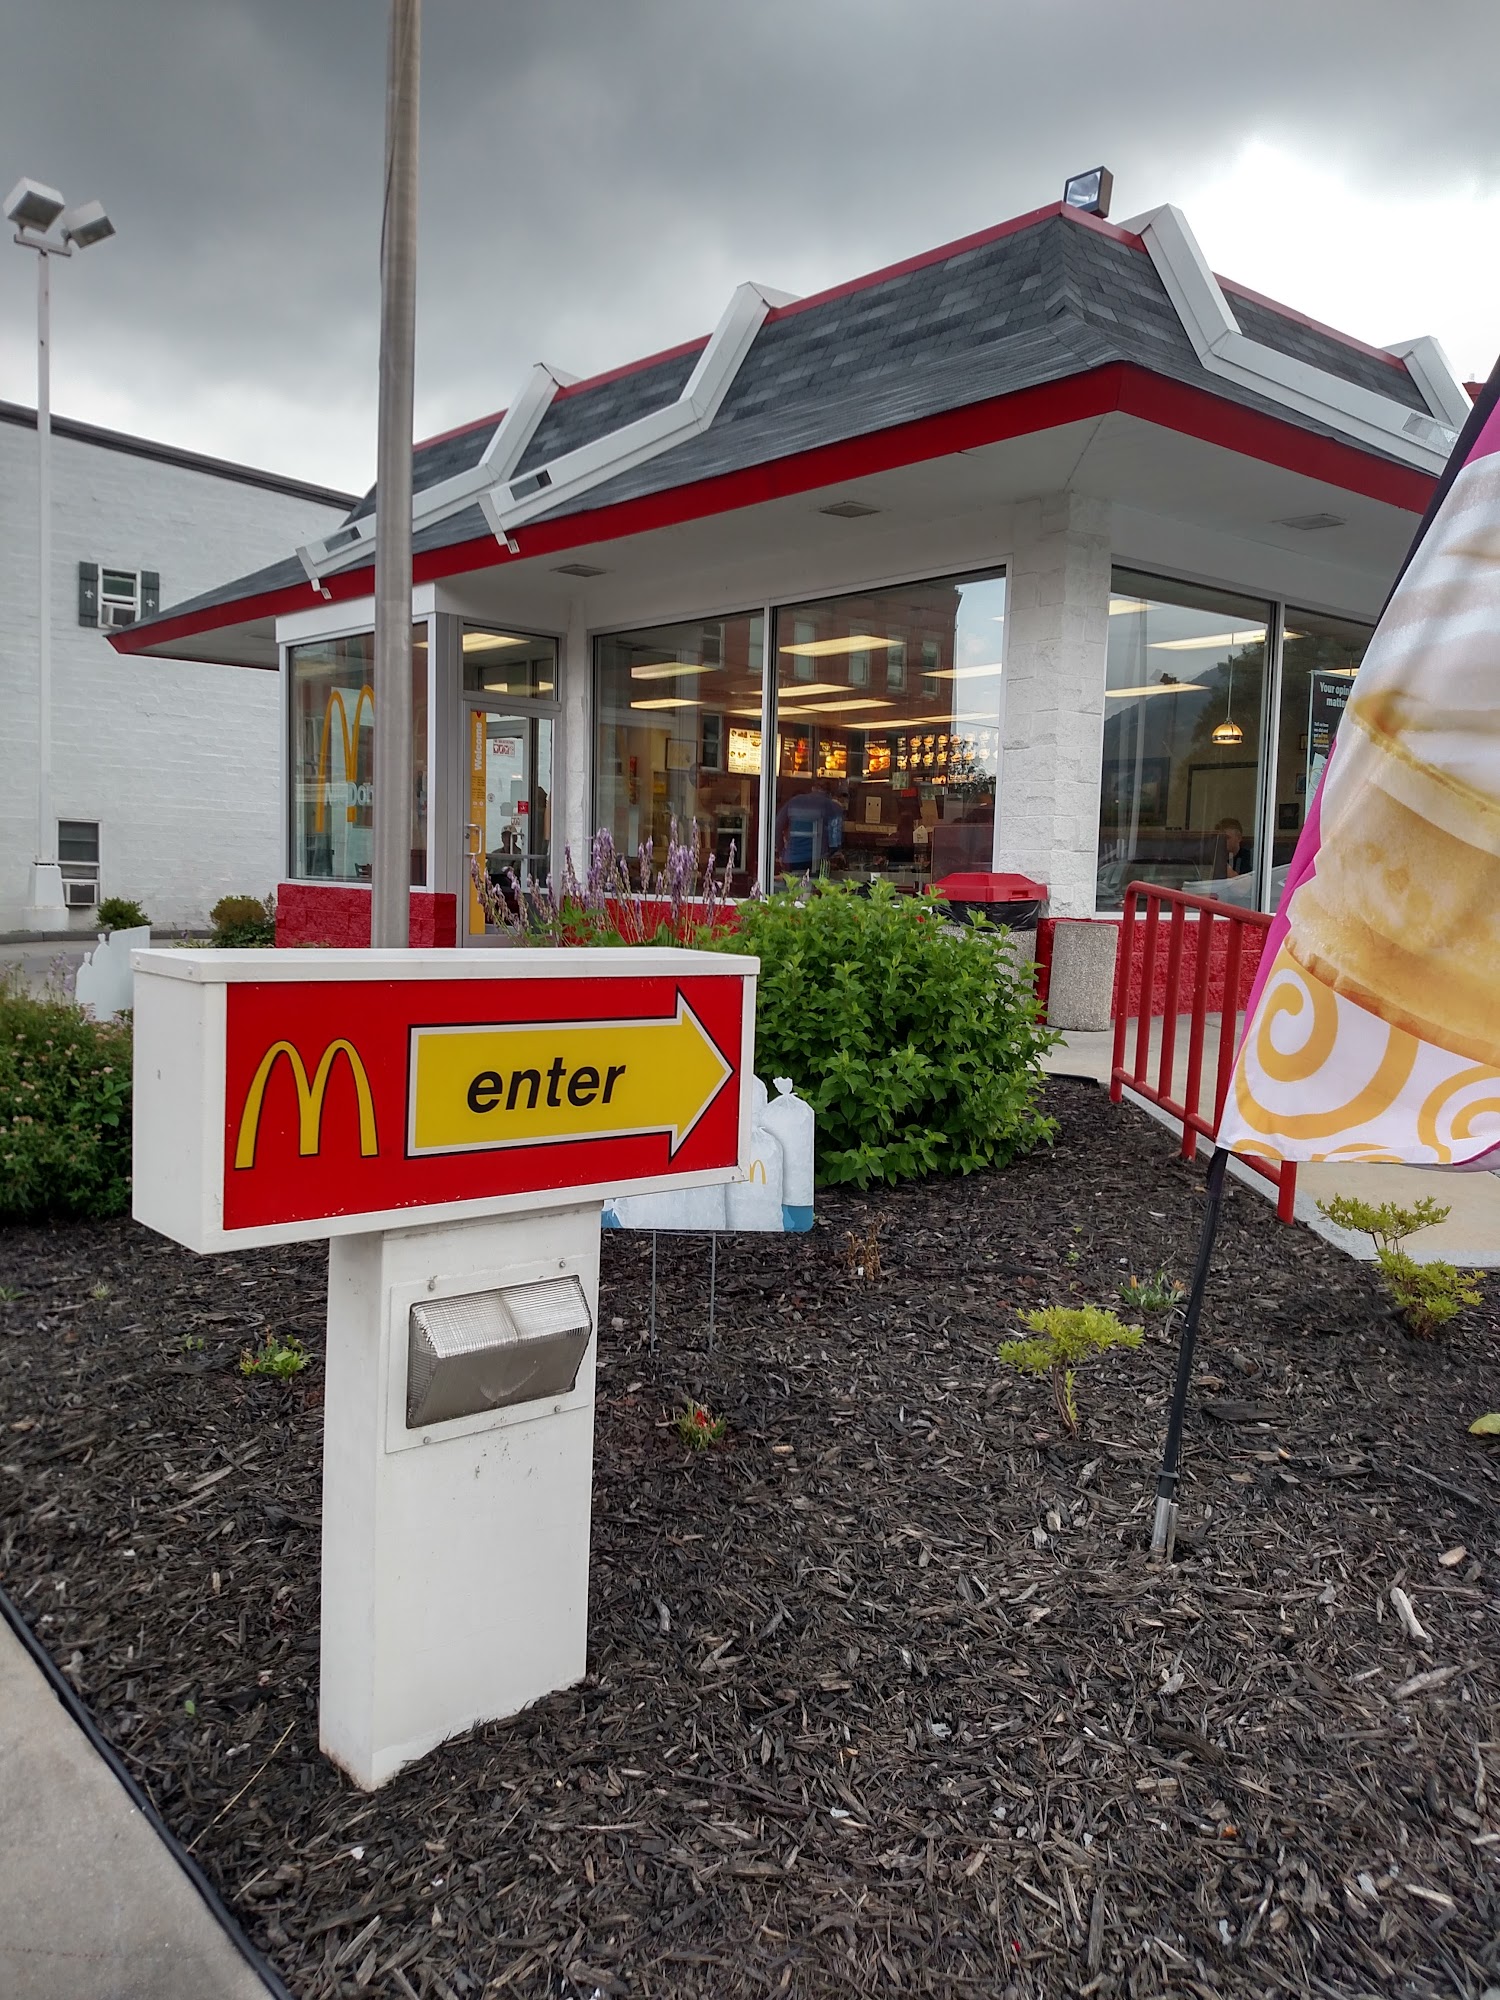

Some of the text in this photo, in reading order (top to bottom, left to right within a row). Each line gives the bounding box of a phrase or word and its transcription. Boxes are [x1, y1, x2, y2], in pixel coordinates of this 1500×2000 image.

[1320, 682, 1335, 693] Your
[474, 722, 483, 771] Welcome
[467, 1057, 627, 1114] enter
